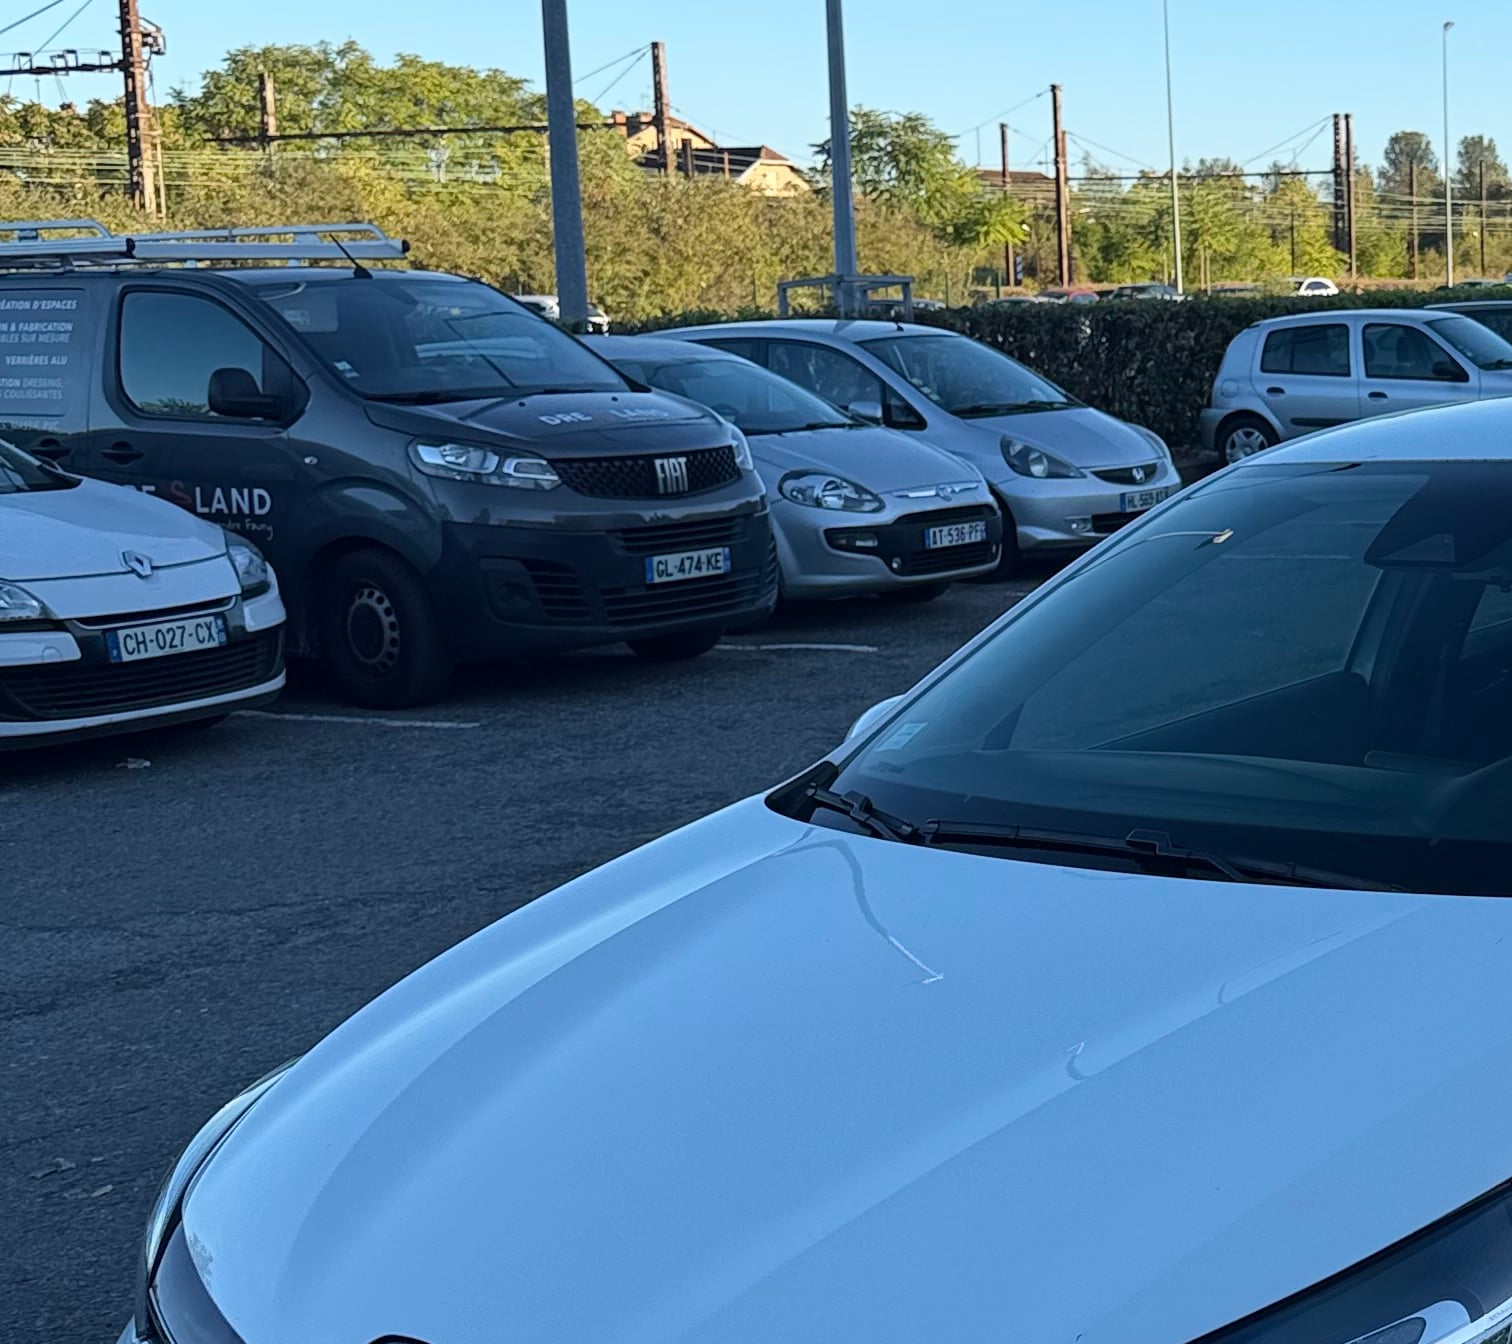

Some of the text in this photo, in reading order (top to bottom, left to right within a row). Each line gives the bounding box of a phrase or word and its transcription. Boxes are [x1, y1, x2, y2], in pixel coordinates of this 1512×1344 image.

[18, 322, 73, 332] FABRICATION
[654, 457, 689, 494] FIAT
[656, 552, 723, 578] GL-474-KE
[123, 621, 216, 655] CH-027-CX
